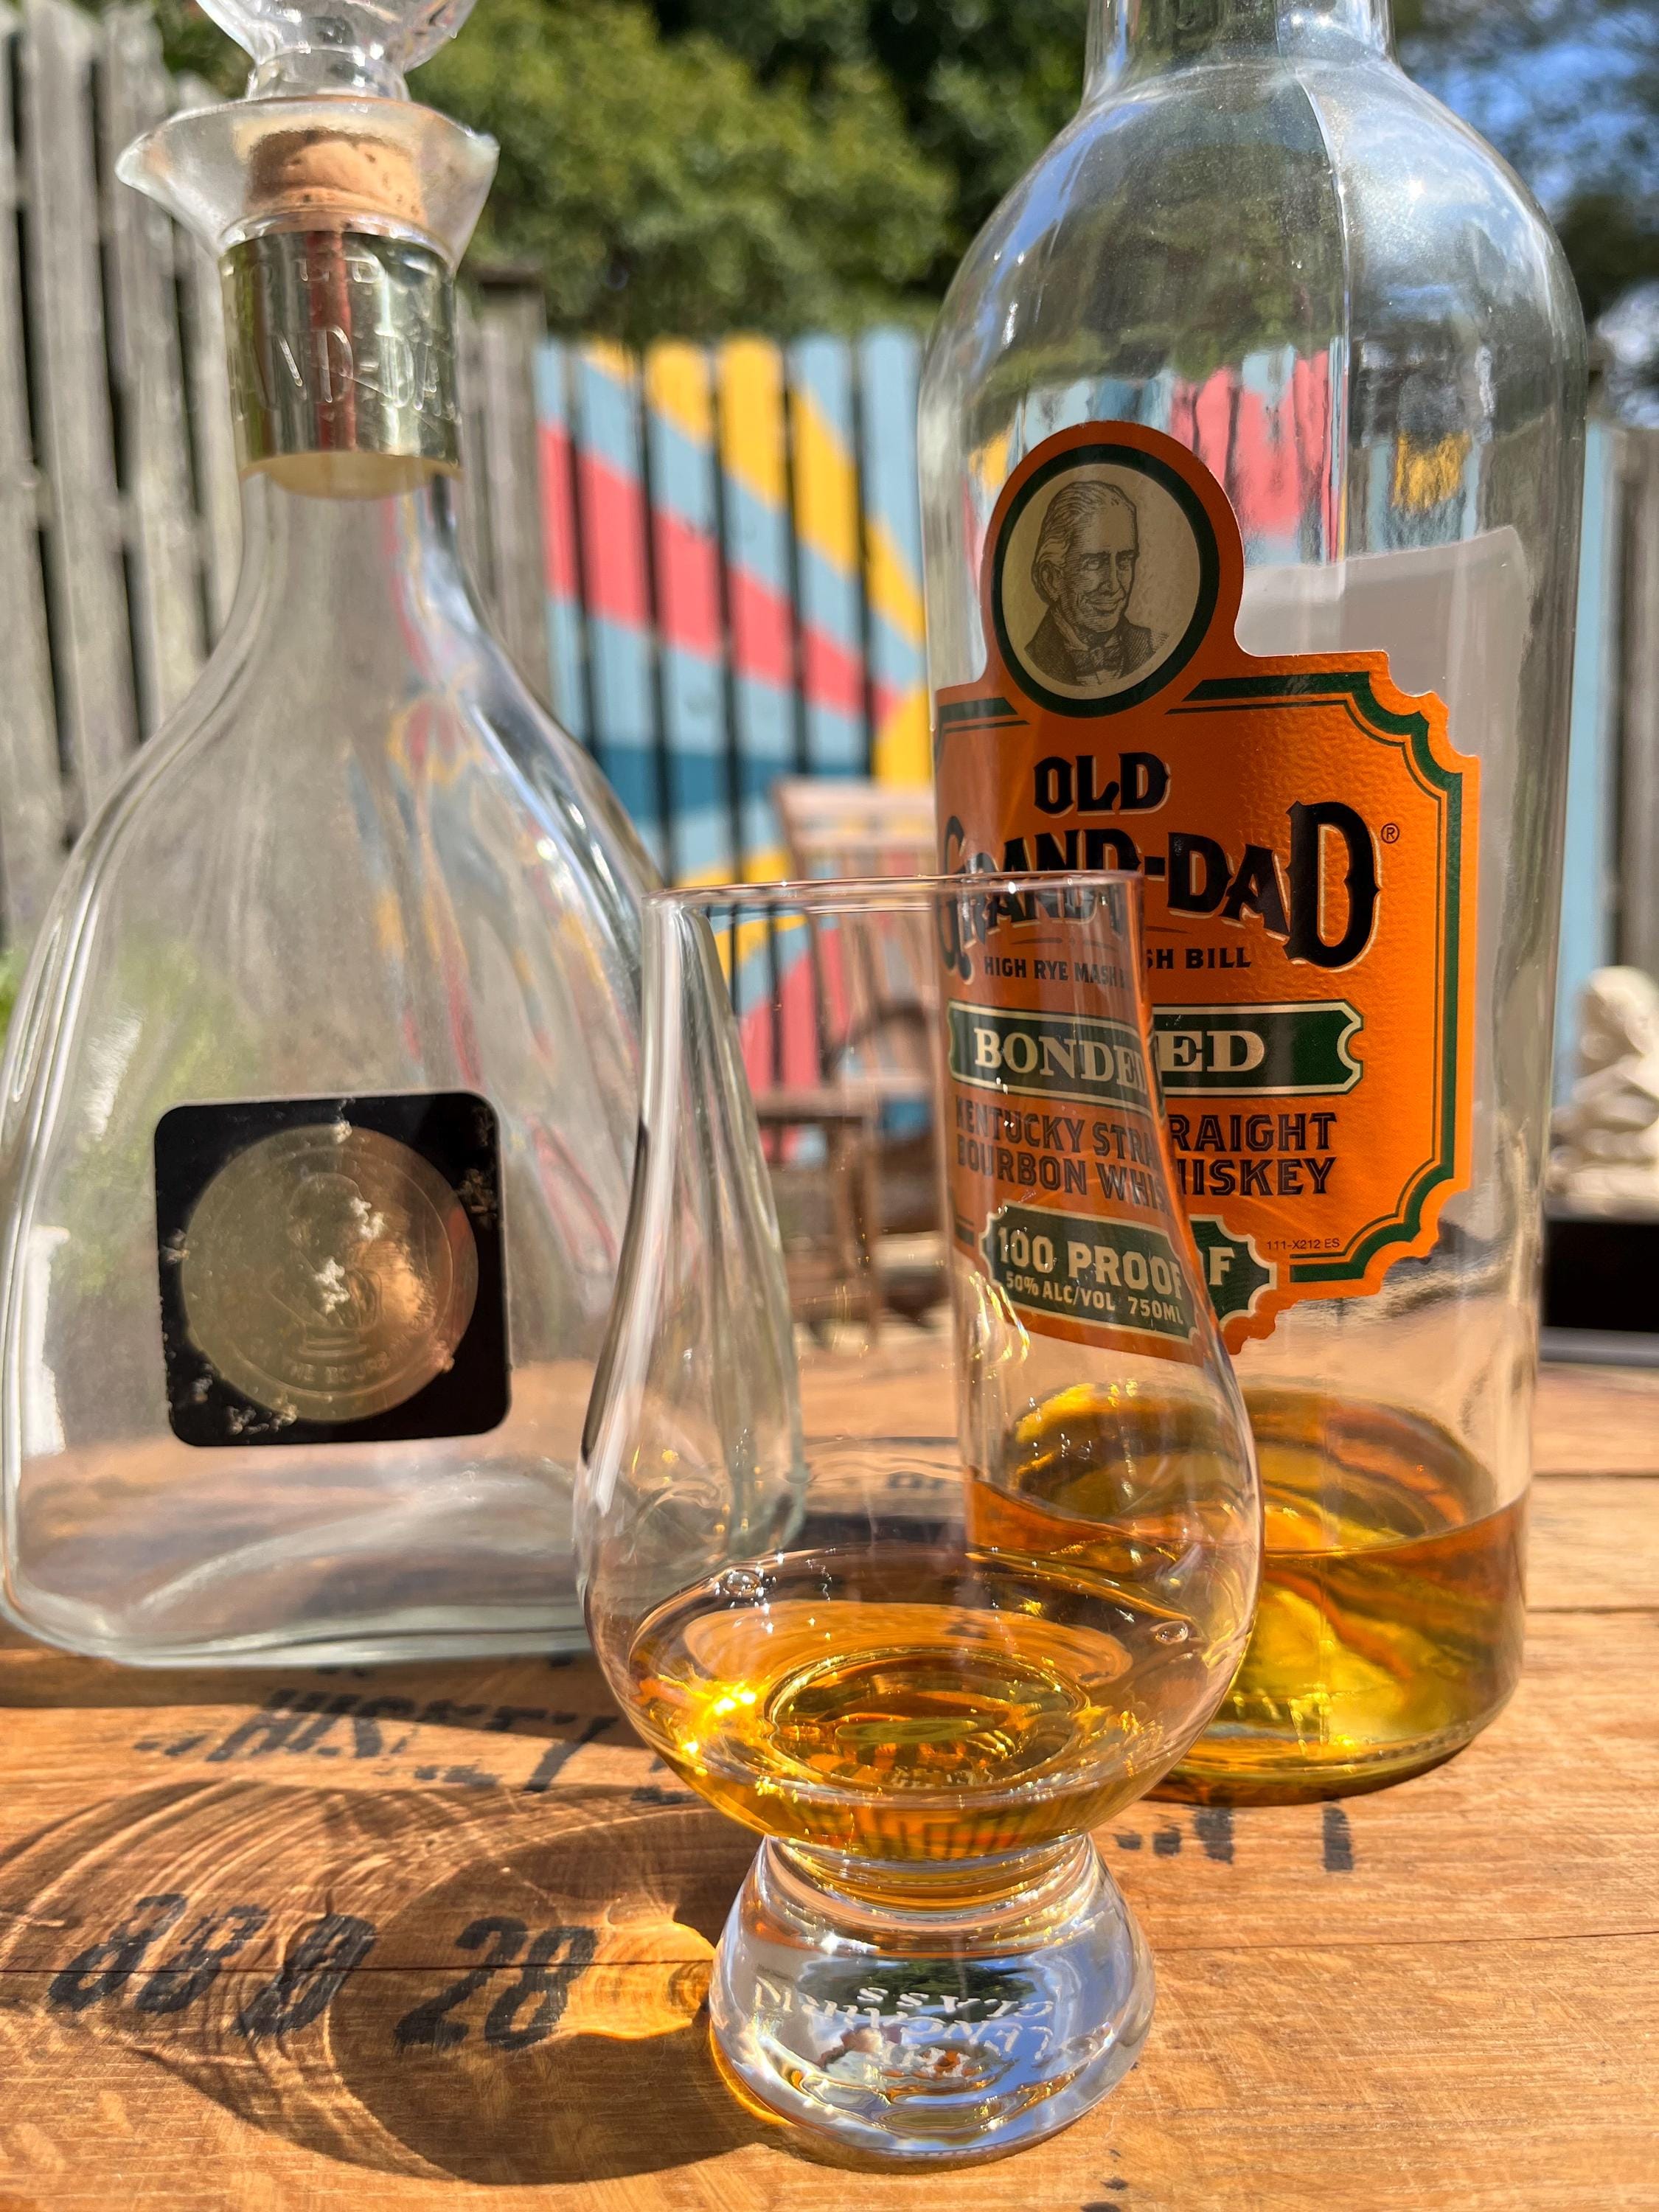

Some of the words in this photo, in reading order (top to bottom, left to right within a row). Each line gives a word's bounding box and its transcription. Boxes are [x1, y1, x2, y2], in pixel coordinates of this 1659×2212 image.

[1034, 752, 1171, 817] OLD
[984, 956, 1026, 978] HIGH
[1034, 960, 1068, 981] RYE
[1185, 947, 1252, 969] BILL
[956, 1095, 1085, 1154] KENTUCKY
[958, 1134, 1088, 1195] BOURBON
[998, 1226, 1054, 1273] 100
[1068, 1240, 1183, 1300] PROOF
[1267, 1239, 1321, 1250] 111-X212
[1324, 1238, 1340, 1248] ES
[1006, 1270, 1039, 1296] 50%
[1042, 1280, 1116, 1311] ALC/VOL
[1128, 1296, 1184, 1325] 750ML
